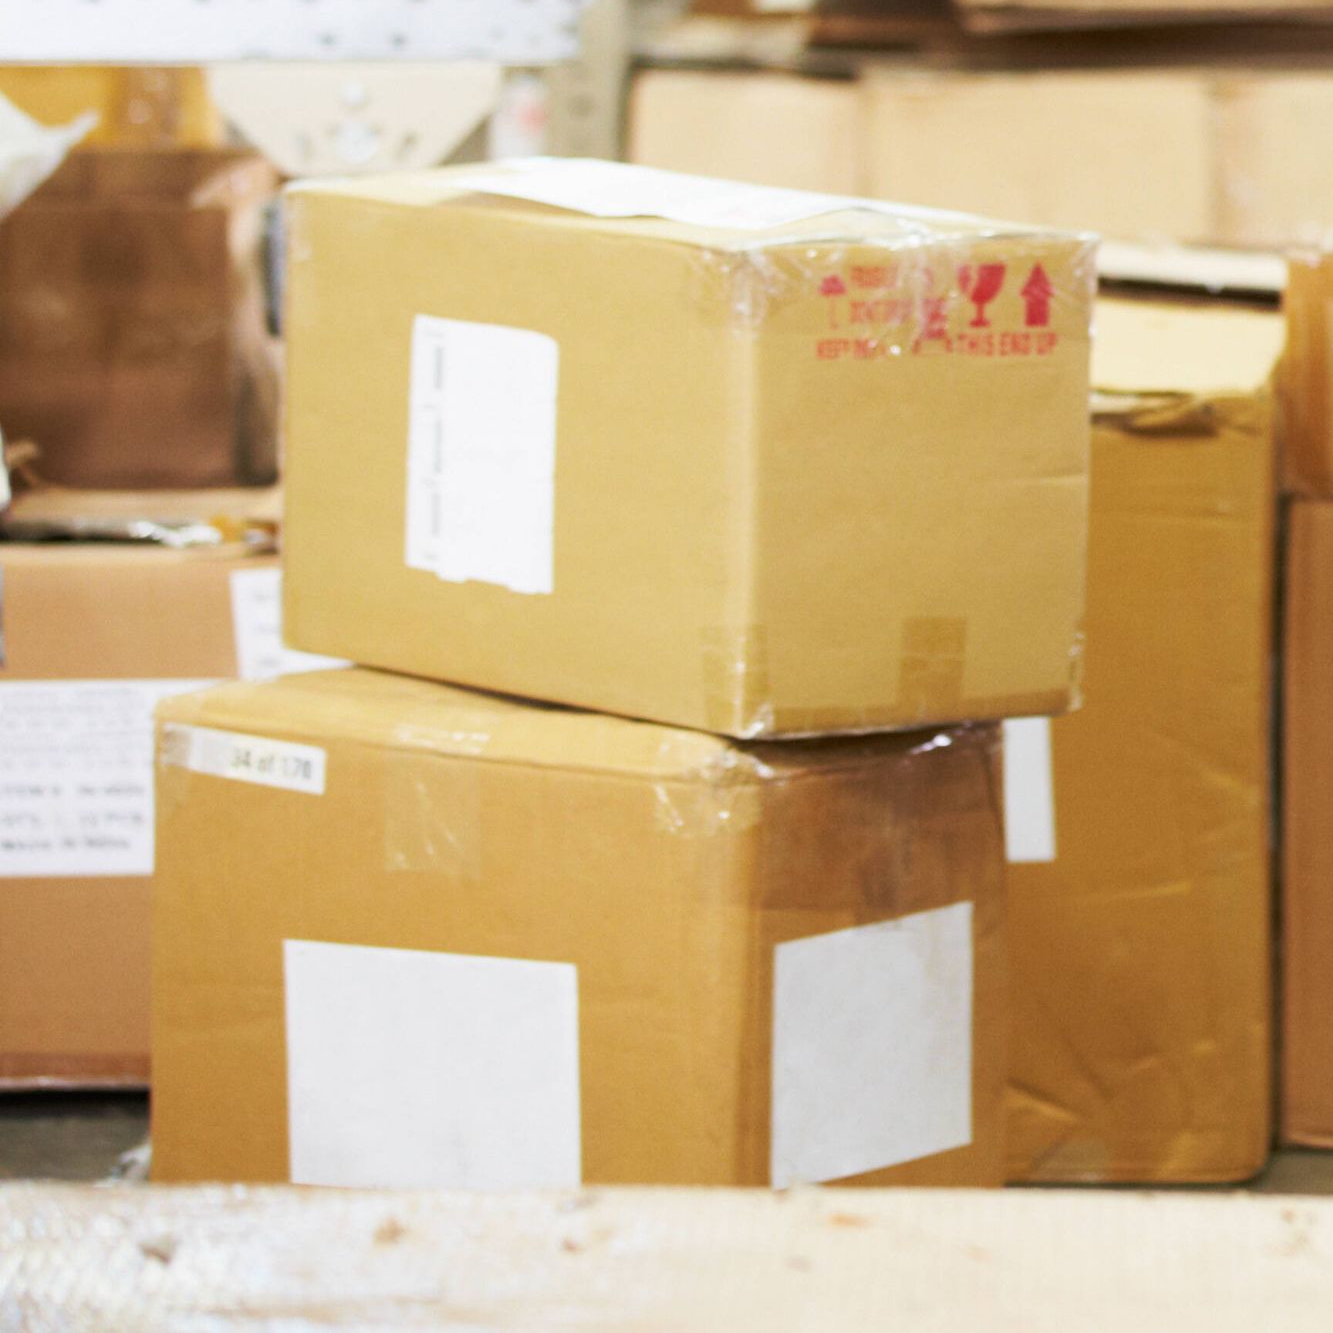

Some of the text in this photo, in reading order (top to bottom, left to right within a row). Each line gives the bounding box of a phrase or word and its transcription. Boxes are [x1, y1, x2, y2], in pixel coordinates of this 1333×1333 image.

[956, 332, 1059, 356] THIS END UP
